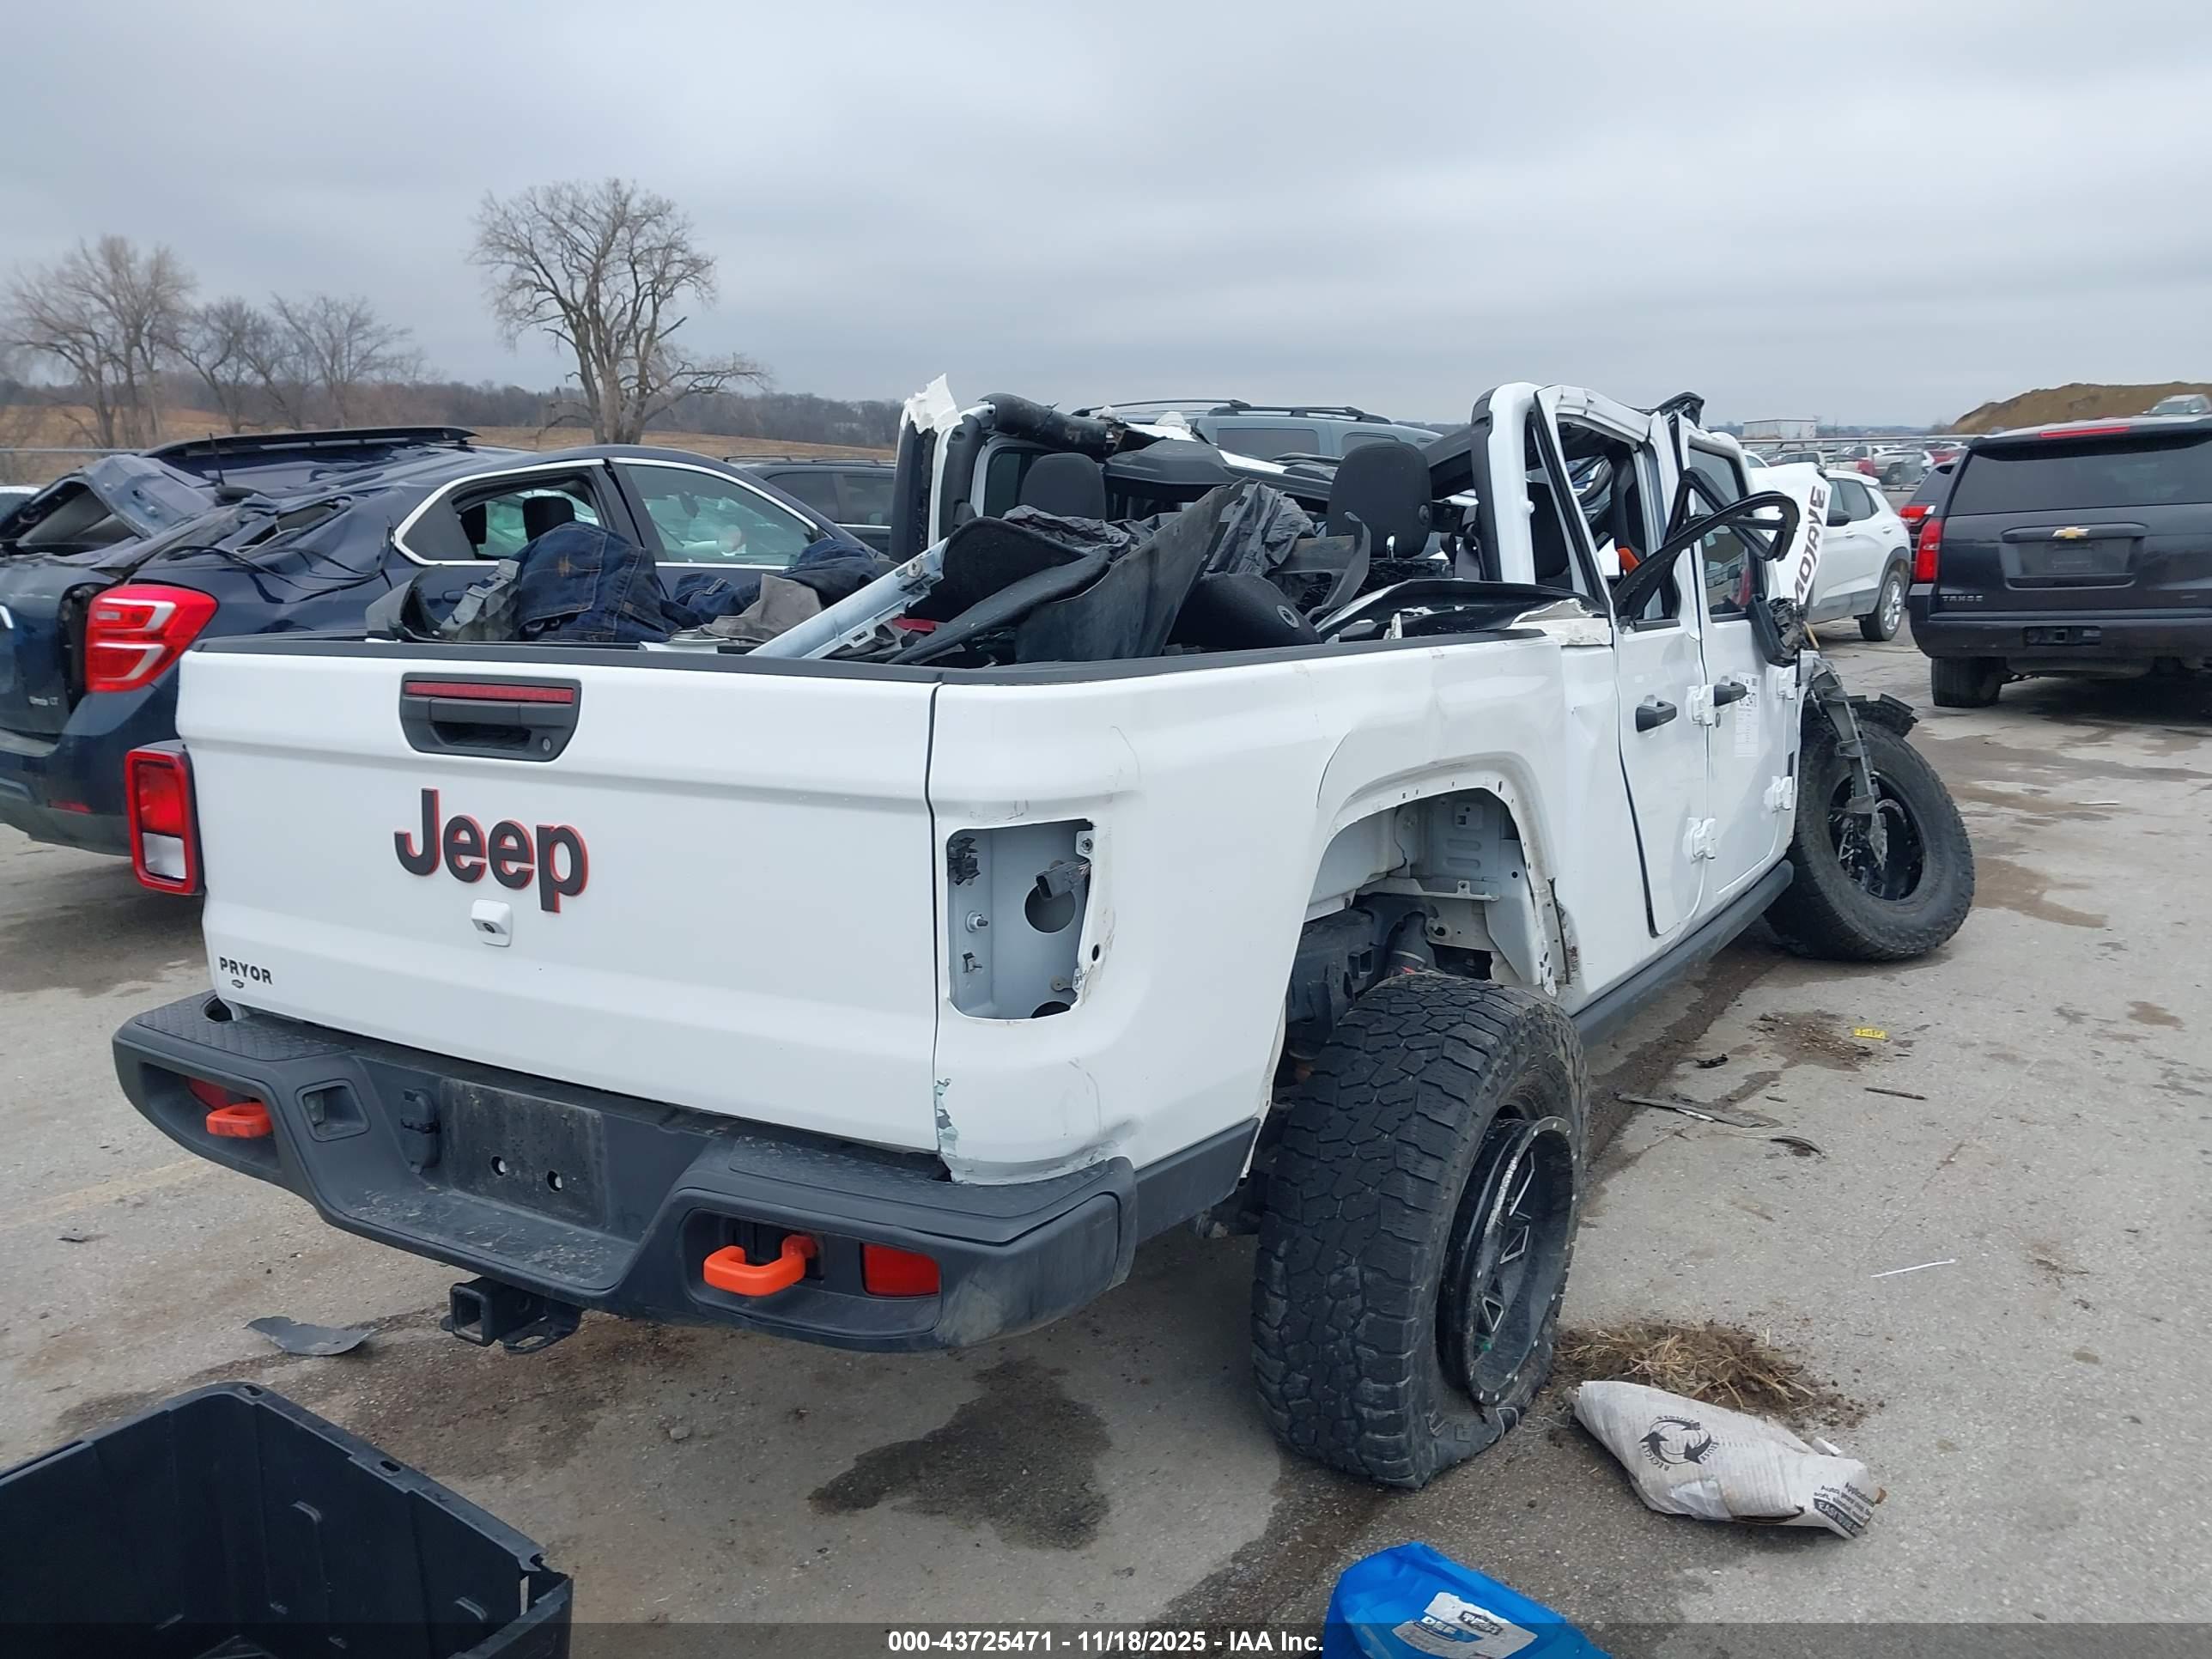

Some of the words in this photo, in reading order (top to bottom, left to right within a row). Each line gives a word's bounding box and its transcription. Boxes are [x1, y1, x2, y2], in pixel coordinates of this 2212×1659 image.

[1942, 594, 1984, 603] TAHOE
[394, 787, 589, 914] Jeep
[219, 956, 273, 985] PRYOR
